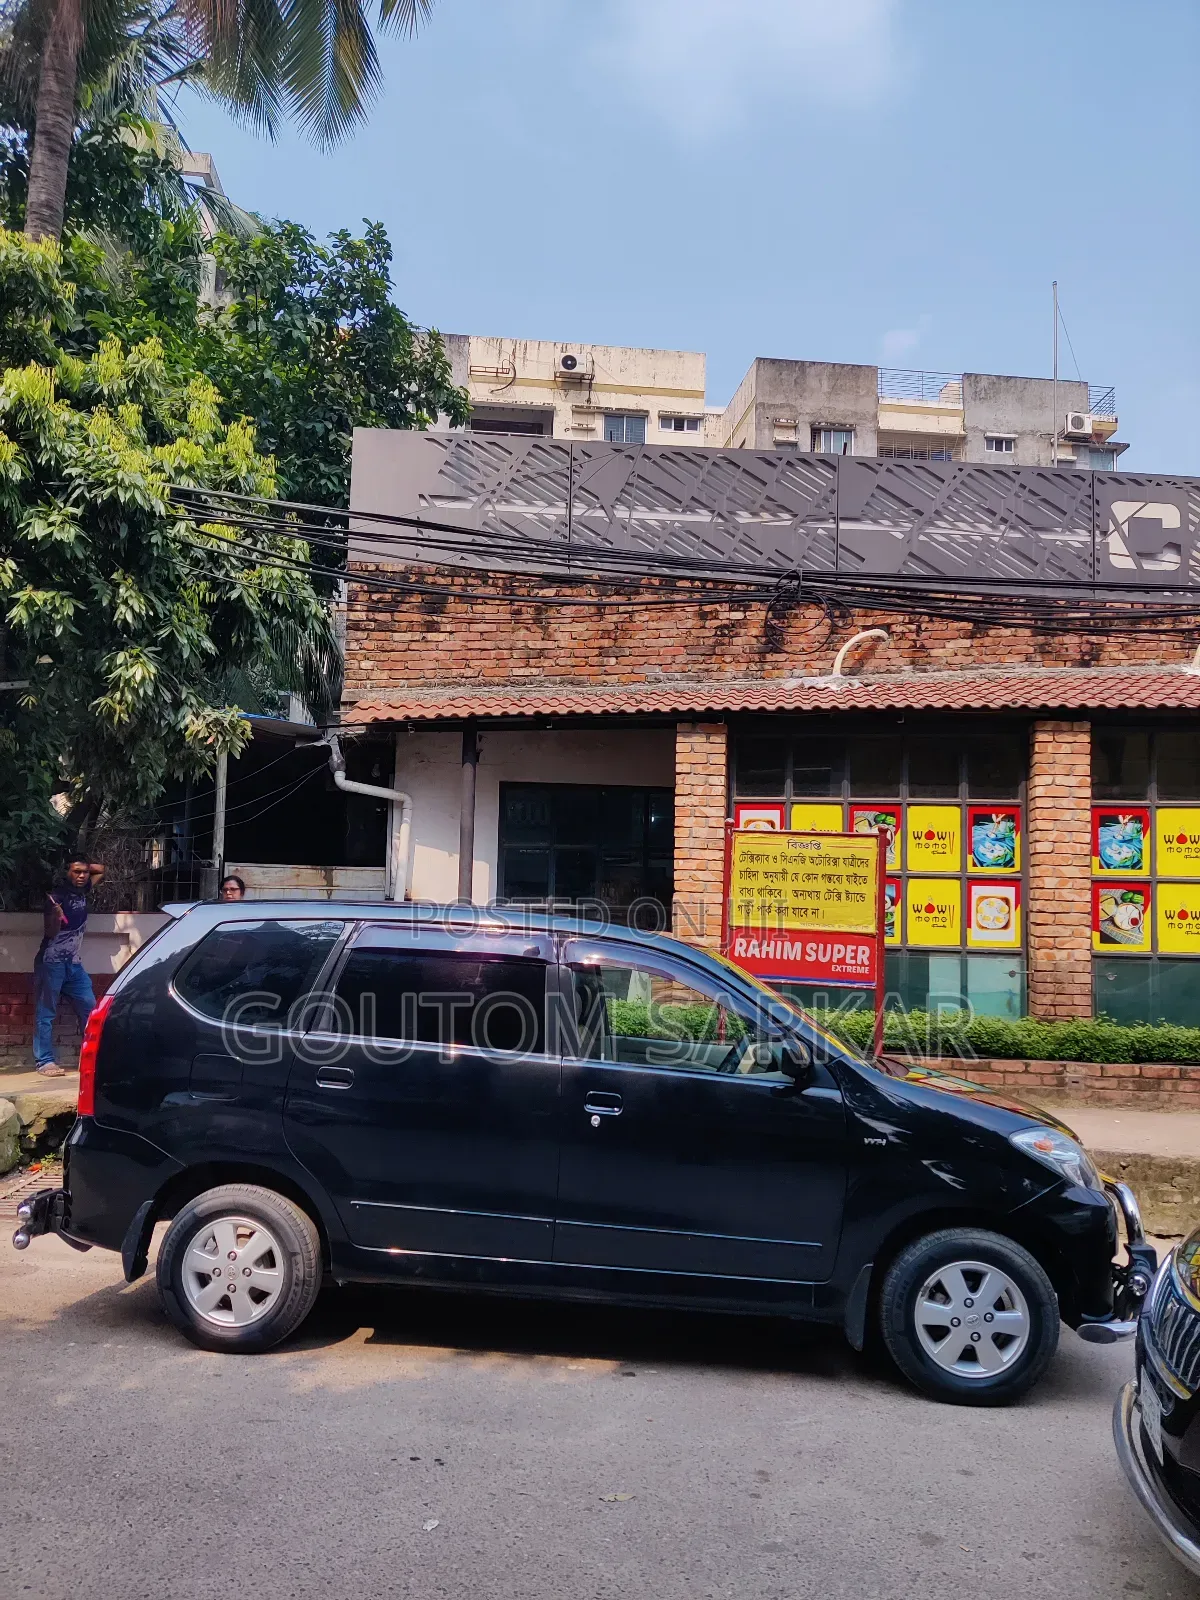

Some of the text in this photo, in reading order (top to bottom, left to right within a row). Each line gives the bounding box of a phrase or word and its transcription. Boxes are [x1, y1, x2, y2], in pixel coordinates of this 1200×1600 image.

[787, 839, 822, 851] বিজ্ঞপ্তি
[772, 855, 778, 864] ও
[780, 851, 807, 866] সিএনজি
[842, 854, 870, 868] যাত্রীদের
[739, 868, 759, 882] চাহিদা
[790, 872, 800, 883] যে
[801, 873, 819, 884] কোন
[845, 873, 868, 886] যাইতে
[739, 886, 755, 898] বাধ্য
[774, 906, 789, 917] করা
[792, 907, 809, 919] যাবে
[734, 938, 870, 966] RAHIM SUPER
[831, 964, 870, 975] EXTREME
